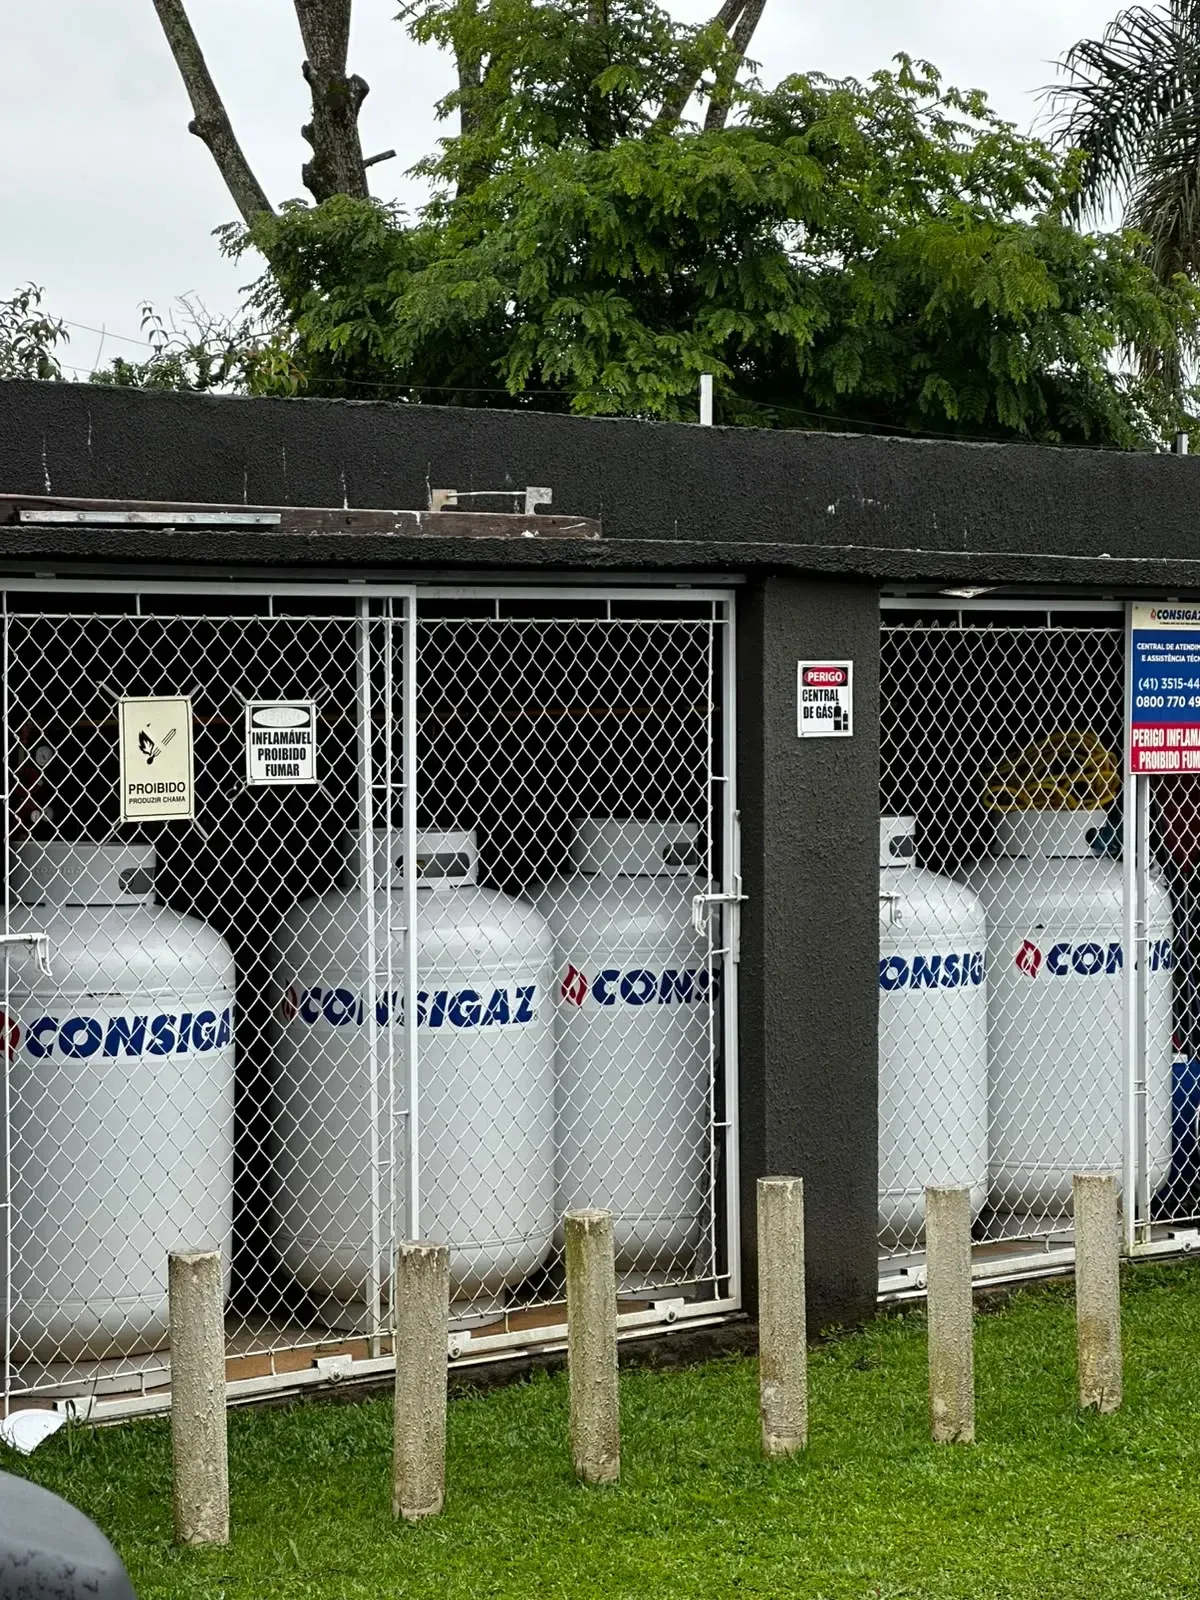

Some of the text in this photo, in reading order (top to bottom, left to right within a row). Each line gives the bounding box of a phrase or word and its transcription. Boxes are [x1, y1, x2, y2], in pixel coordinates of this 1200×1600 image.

[1147, 653, 1186, 662] ASSISTÊNCIA
[807, 671, 843, 682] PERIGO
[1138, 677, 1200, 691] (41) 3515-44
[802, 688, 839, 702] CENTRAL
[1136, 695, 1164, 708] 0800
[1166, 695, 1186, 708] 770
[803, 703, 833, 719] DE GÁS
[252, 729, 312, 745] INFLAMÁVEL
[1132, 728, 1200, 747] PERIGO INFLAM
[257, 747, 307, 761] PROIBIDO
[1138, 750, 1180, 770] PROIBIDO
[265, 763, 300, 777] FUMAR
[128, 781, 186, 795] PROIBIDO
[128, 795, 186, 805] PRODUZIR CHAMA
[25, 1006, 234, 1059] CONSIGA
